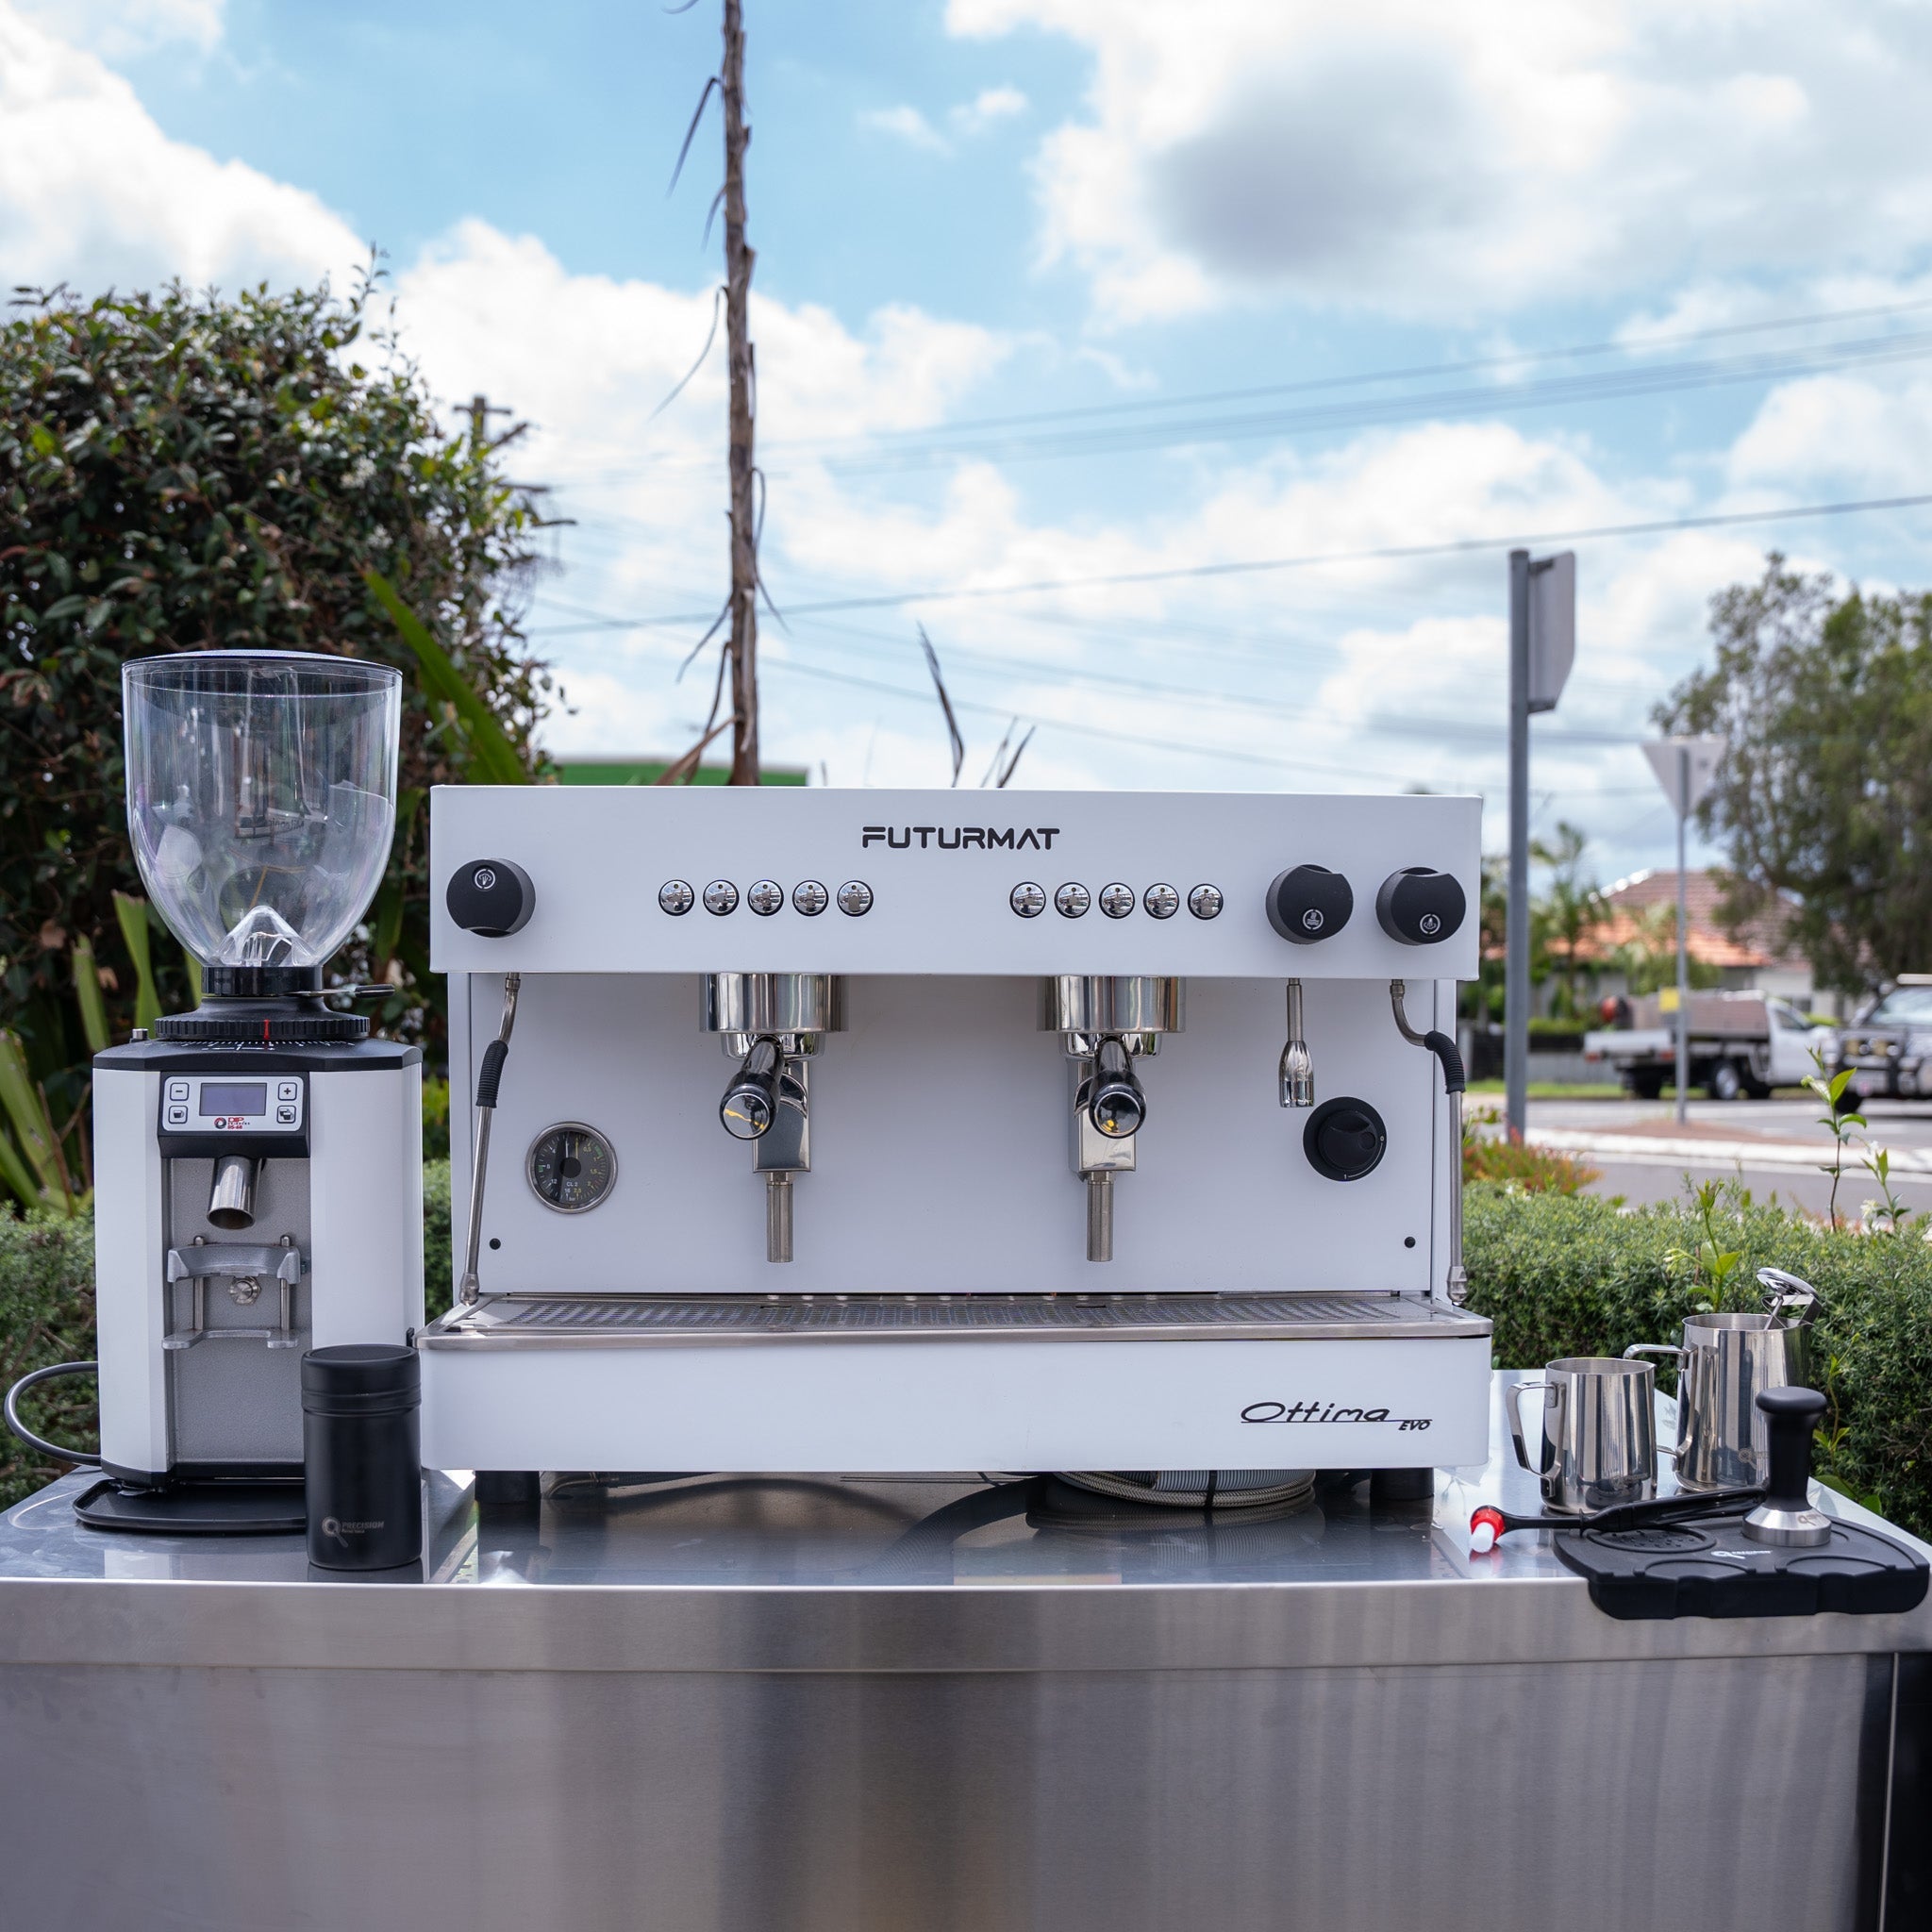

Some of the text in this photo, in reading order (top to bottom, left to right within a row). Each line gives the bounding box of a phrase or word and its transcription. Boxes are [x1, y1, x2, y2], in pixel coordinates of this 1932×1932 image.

[862, 826, 1060, 850] FUTURMAT
[1241, 1401, 1431, 1431] Ottima EVO
[341, 1521, 385, 1529] PRECISION
